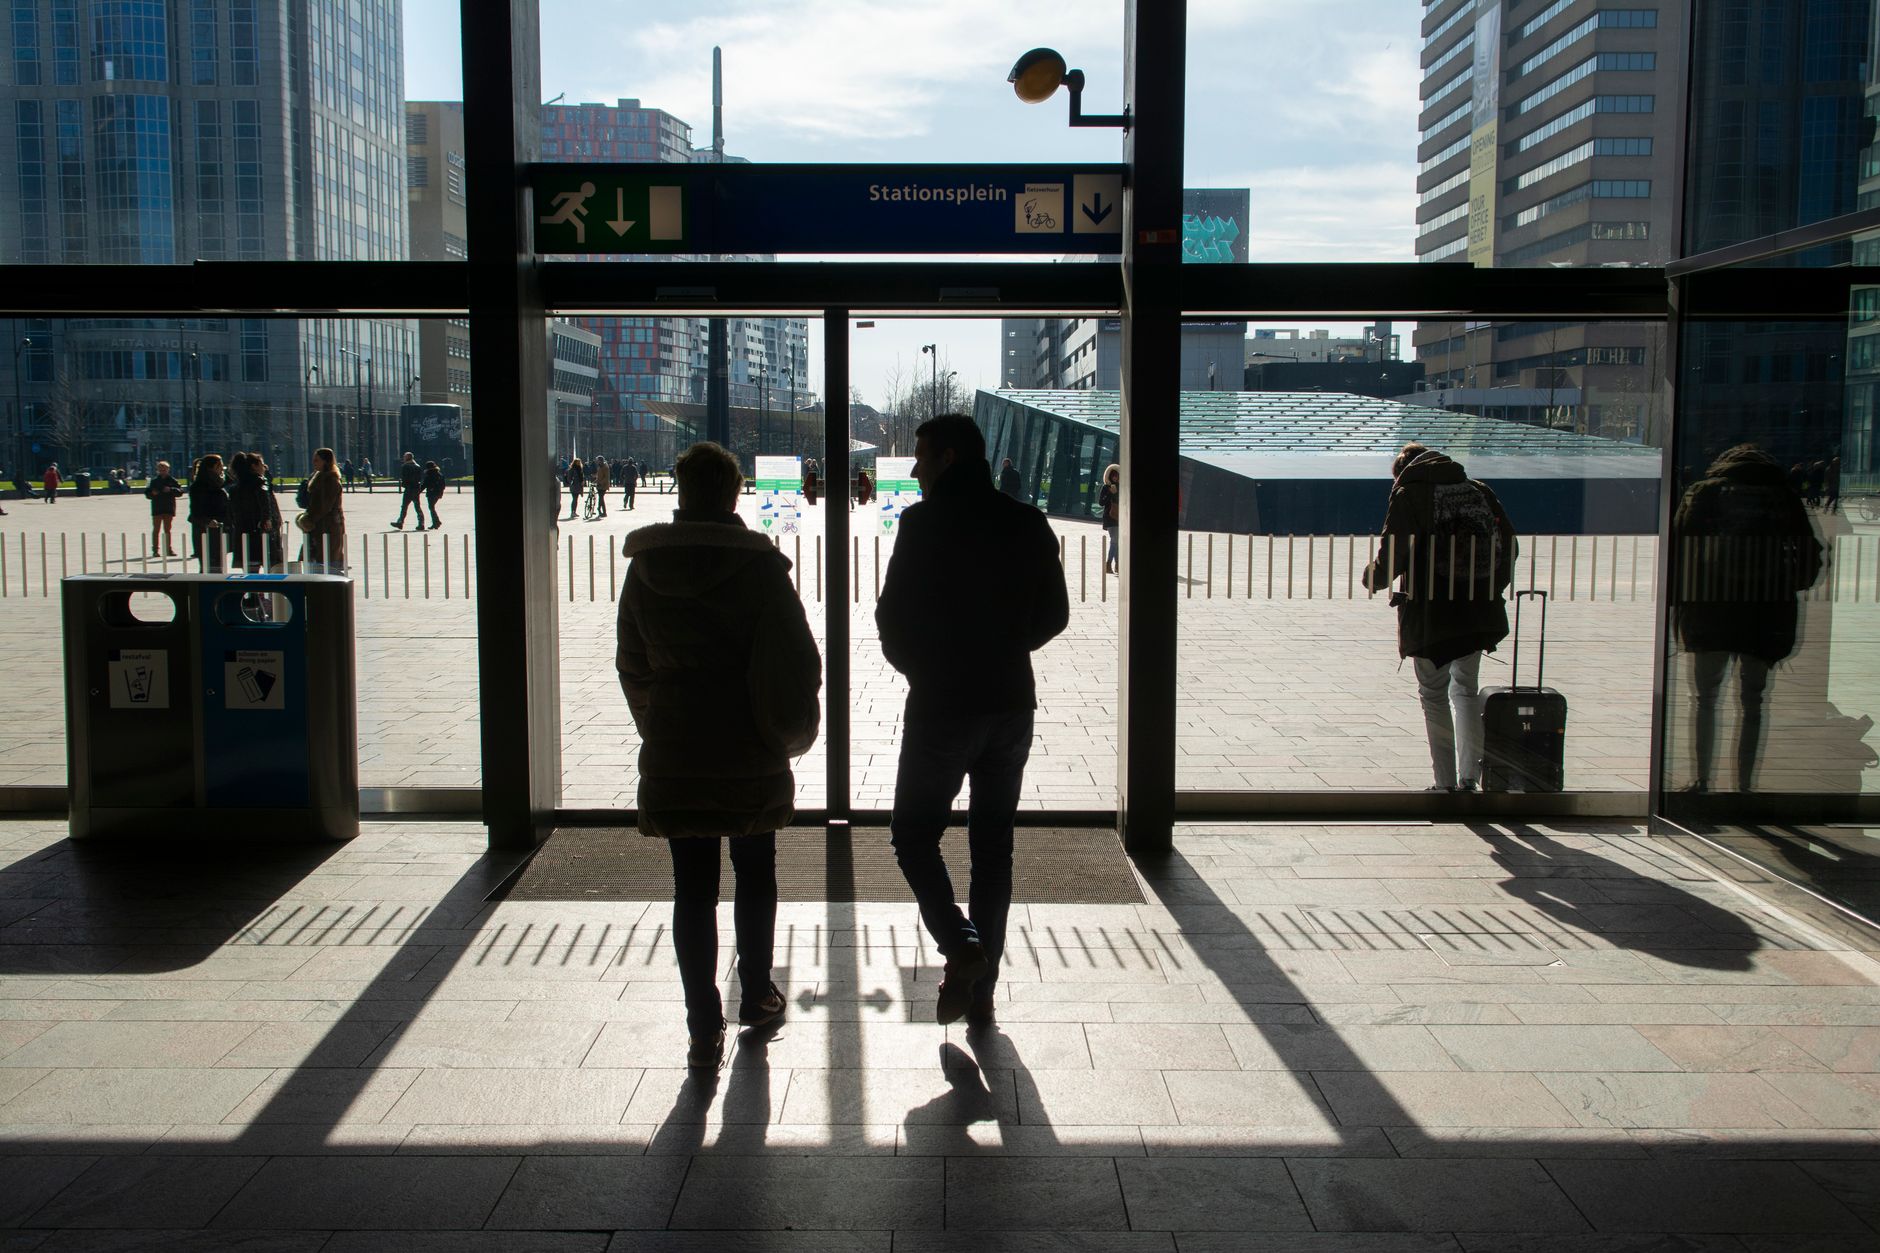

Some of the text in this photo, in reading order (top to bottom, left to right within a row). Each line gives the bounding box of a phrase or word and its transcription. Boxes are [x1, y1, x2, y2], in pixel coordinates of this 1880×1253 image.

[1473, 129, 1495, 155] OPENING
[869, 184, 1007, 205] Stationsplein
[1183, 214, 1240, 234] EUM
[1470, 209, 1489, 229] OFFICE
[1183, 238, 1235, 257] CHT
